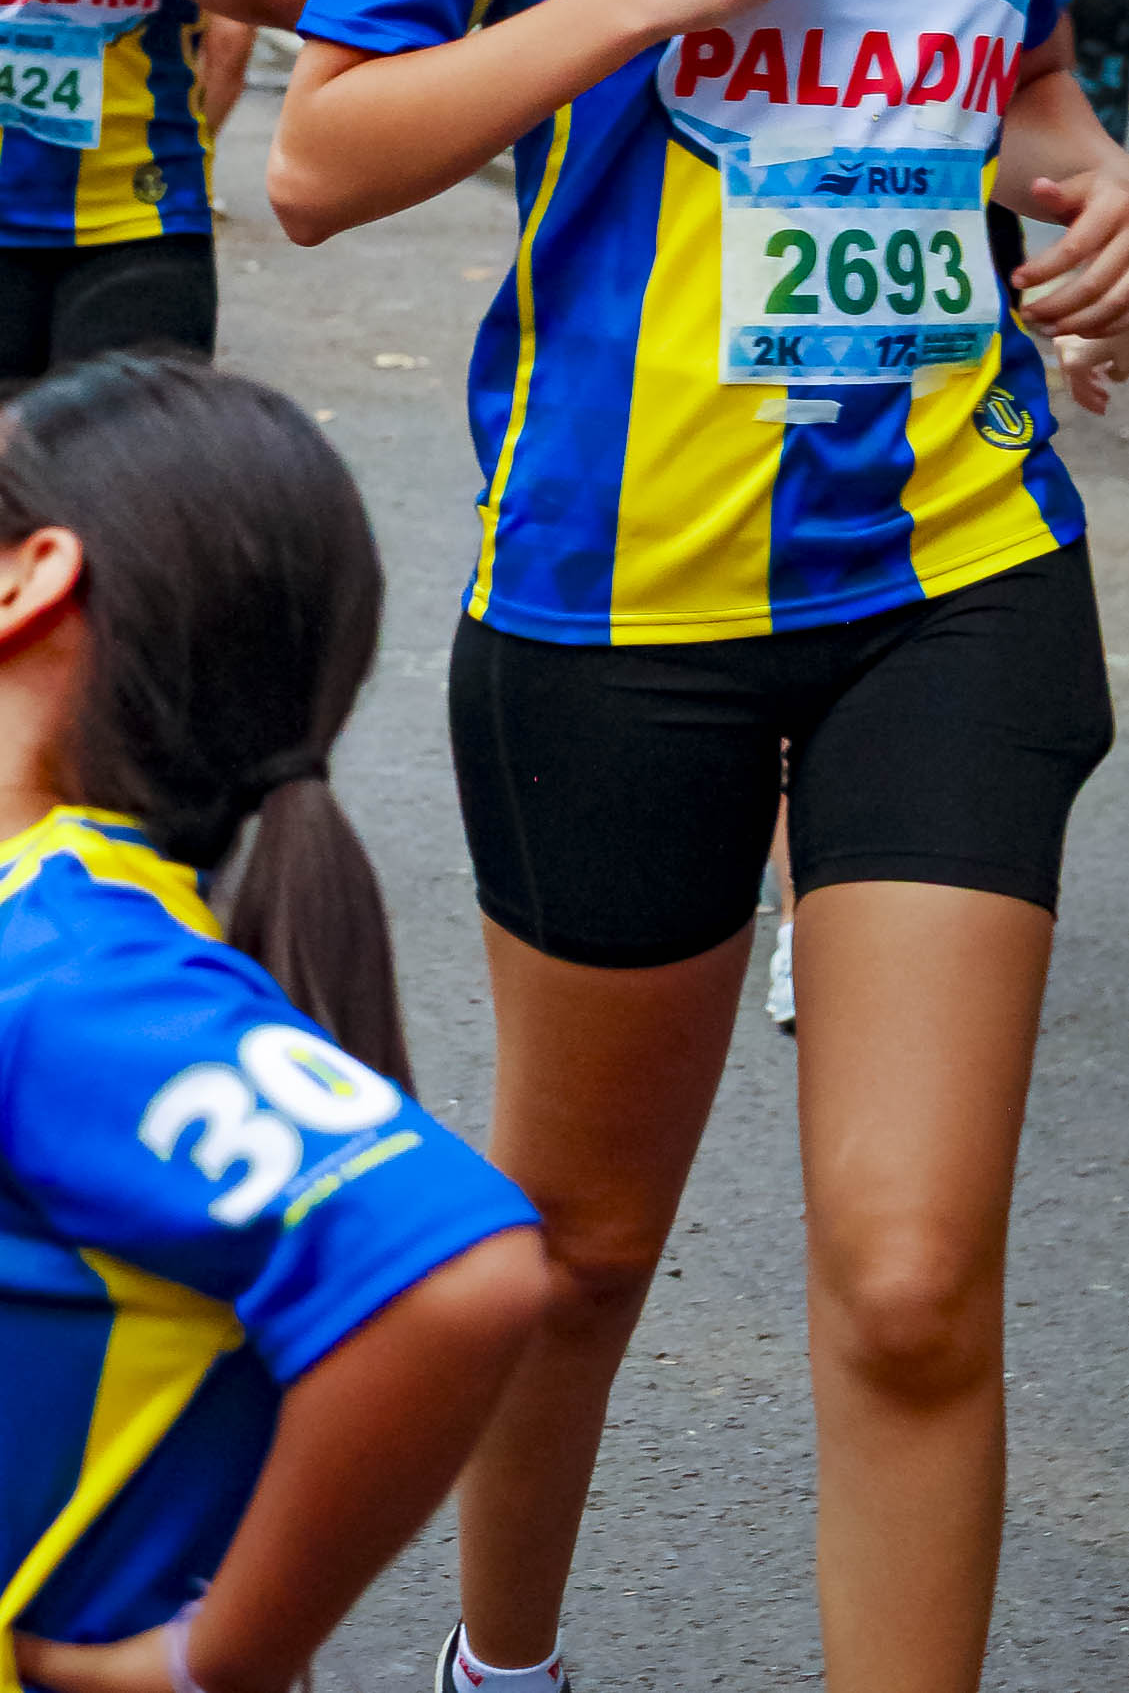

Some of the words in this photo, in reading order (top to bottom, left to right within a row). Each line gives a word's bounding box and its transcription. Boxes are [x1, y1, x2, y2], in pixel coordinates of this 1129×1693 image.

[867, 166, 930, 196] RUS
[764, 227, 973, 317] 2693
[752, 334, 805, 367] 2K
[137, 1022, 403, 1229] 30
